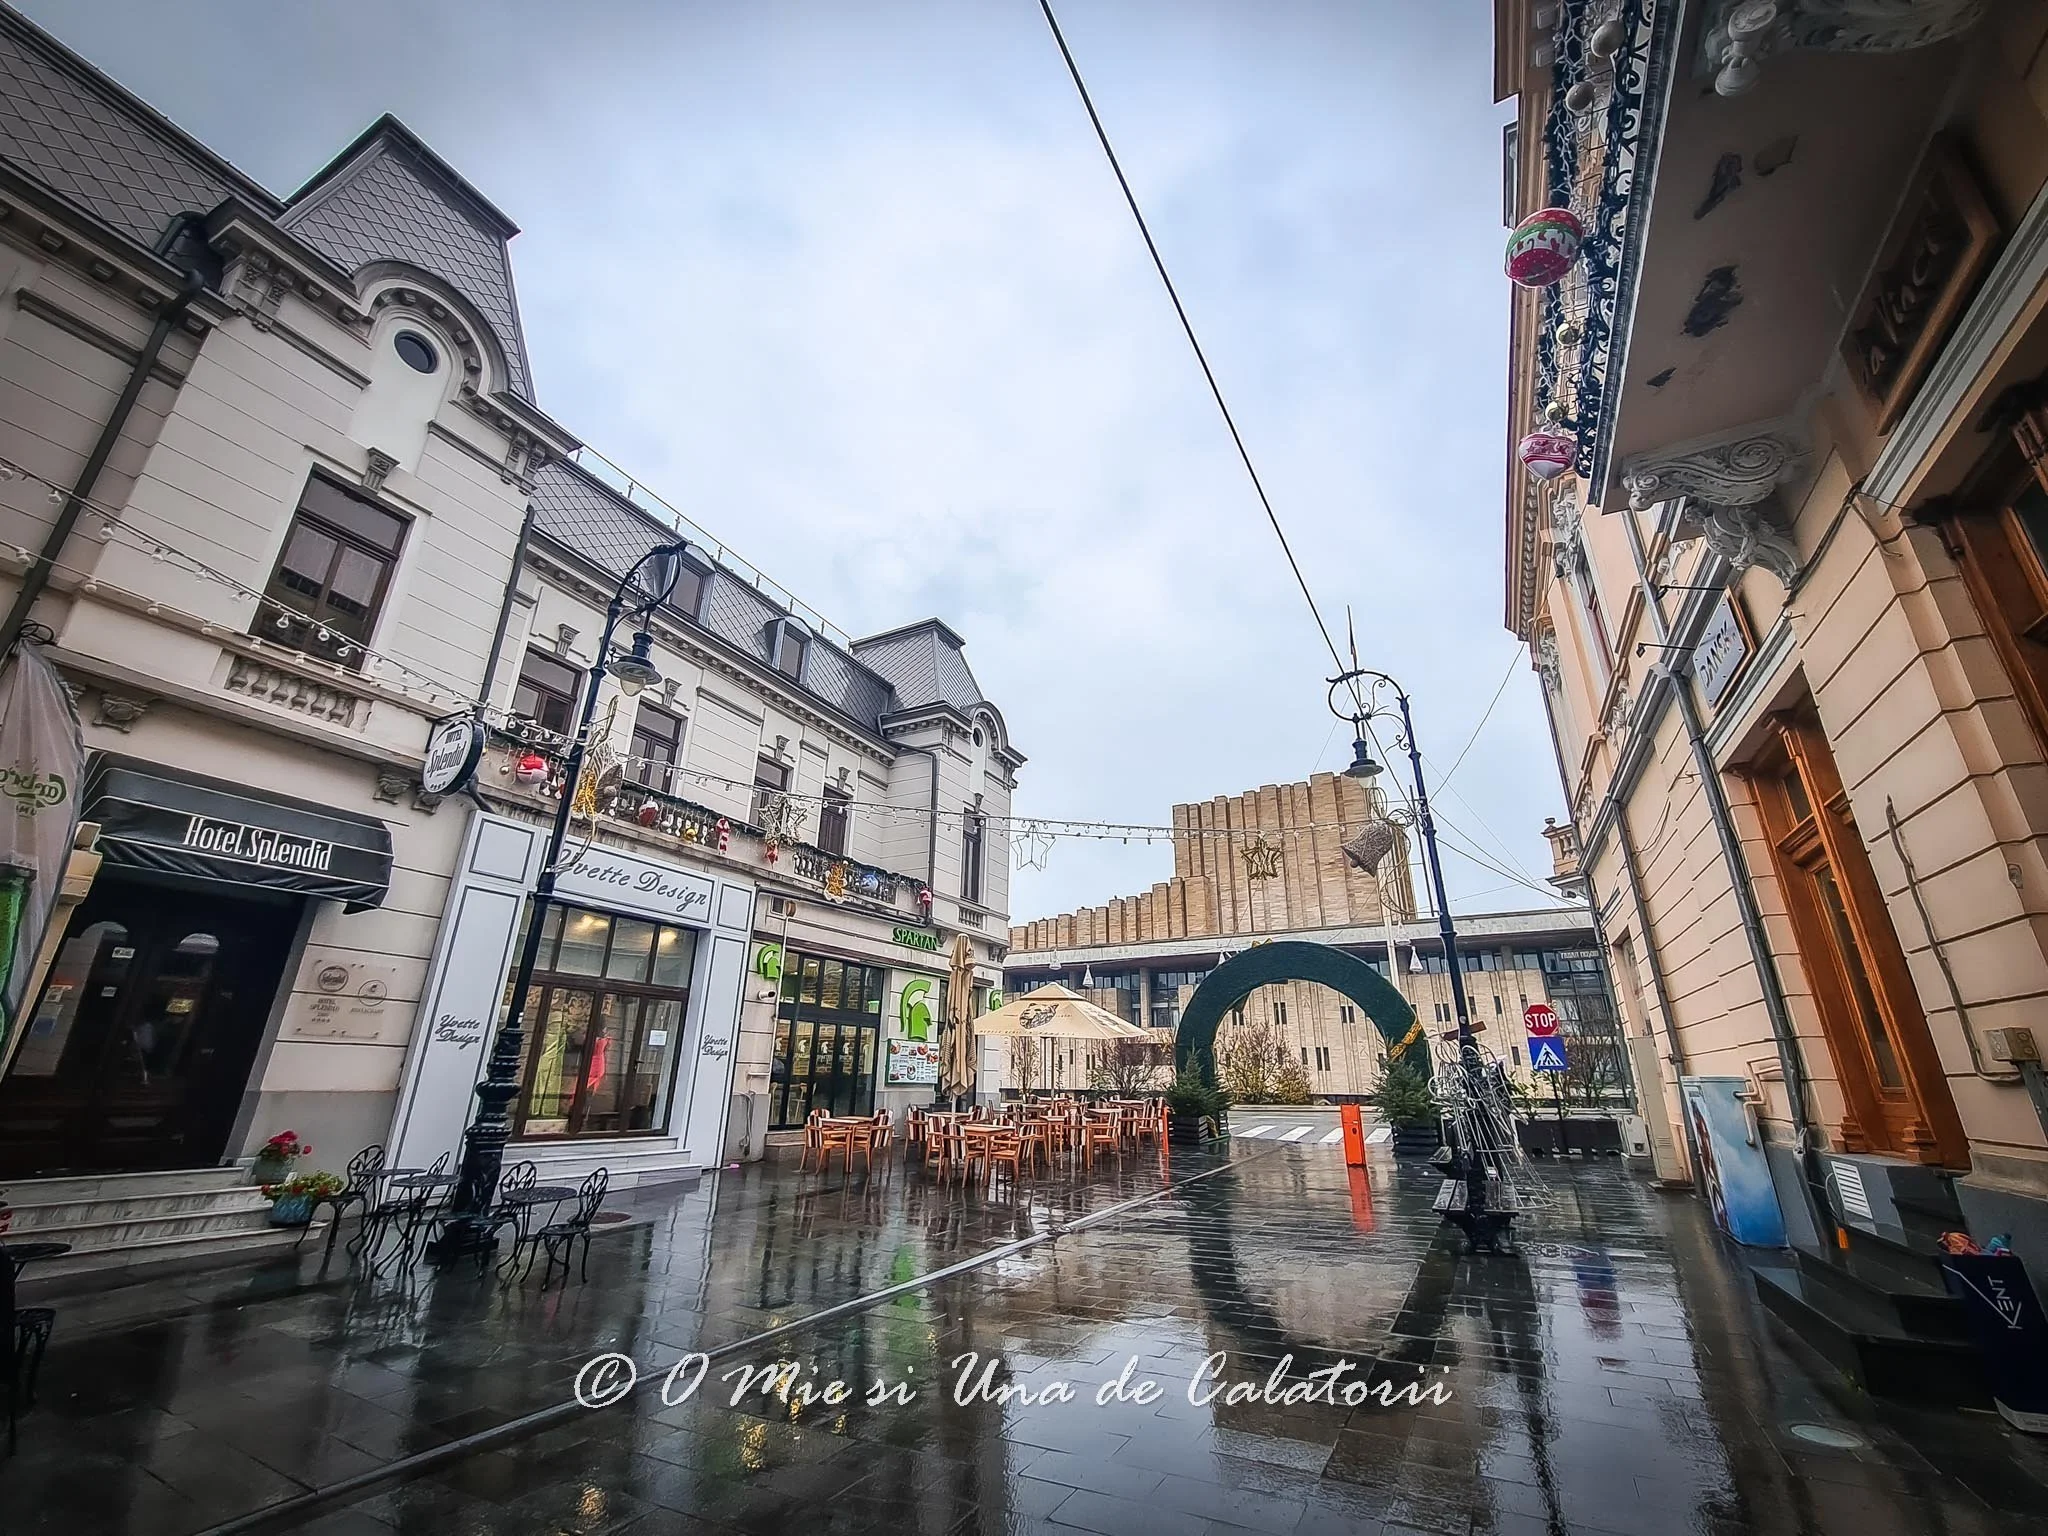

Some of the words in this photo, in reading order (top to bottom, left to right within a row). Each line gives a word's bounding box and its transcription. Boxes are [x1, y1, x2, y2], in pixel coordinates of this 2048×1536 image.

[445, 728, 463, 744] HOTEL
[426, 741, 467, 778] Splendid
[182, 816, 246, 855] Hotel
[246, 828, 334, 872] Splendid
[555, 848, 632, 887] Yvette
[632, 870, 707, 912] Design
[892, 927, 938, 951] SPARTAN
[435, 1014, 481, 1035] Yvette
[1525, 1012, 1556, 1029] STOP
[436, 1028, 481, 1050] Design
[701, 1034, 729, 1050] Yvette
[702, 1045, 729, 1062] Design
[1986, 1274, 2024, 1330] KENT
